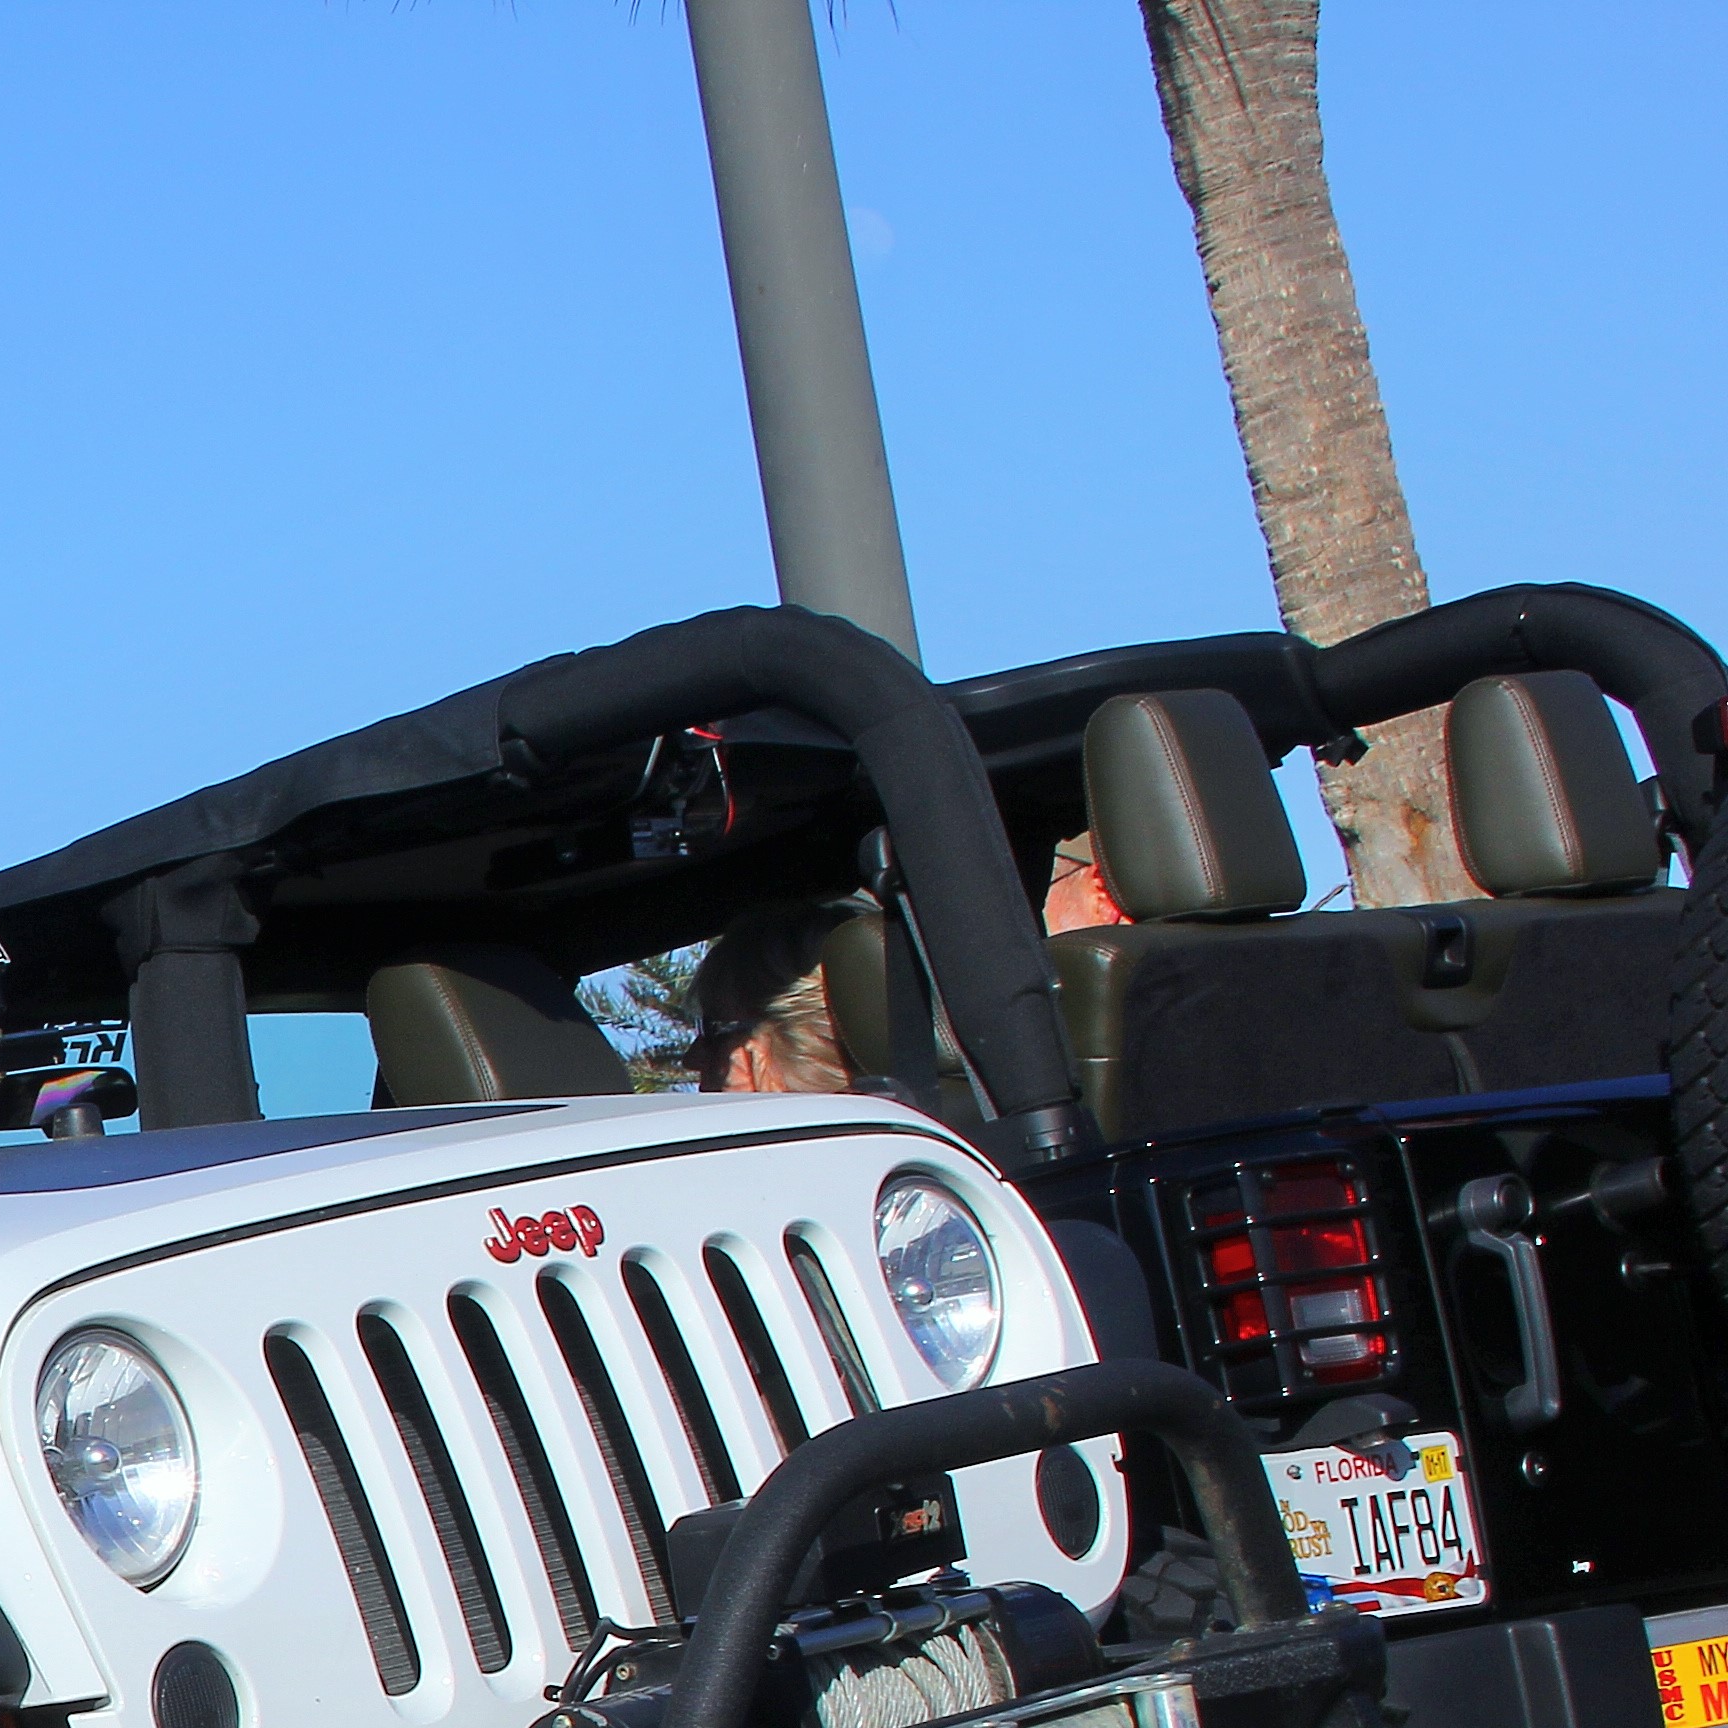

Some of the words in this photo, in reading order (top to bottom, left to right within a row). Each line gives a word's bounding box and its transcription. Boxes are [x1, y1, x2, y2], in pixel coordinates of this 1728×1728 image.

[484, 1204, 605, 1264] Jeep
[1313, 1453, 1397, 1484] FLORIDA
[1282, 1511, 1308, 1533] OD
[1339, 1485, 1464, 1576] IAF84
[1290, 1533, 1332, 1559] RUST
[1651, 1650, 1685, 1720] USMC
